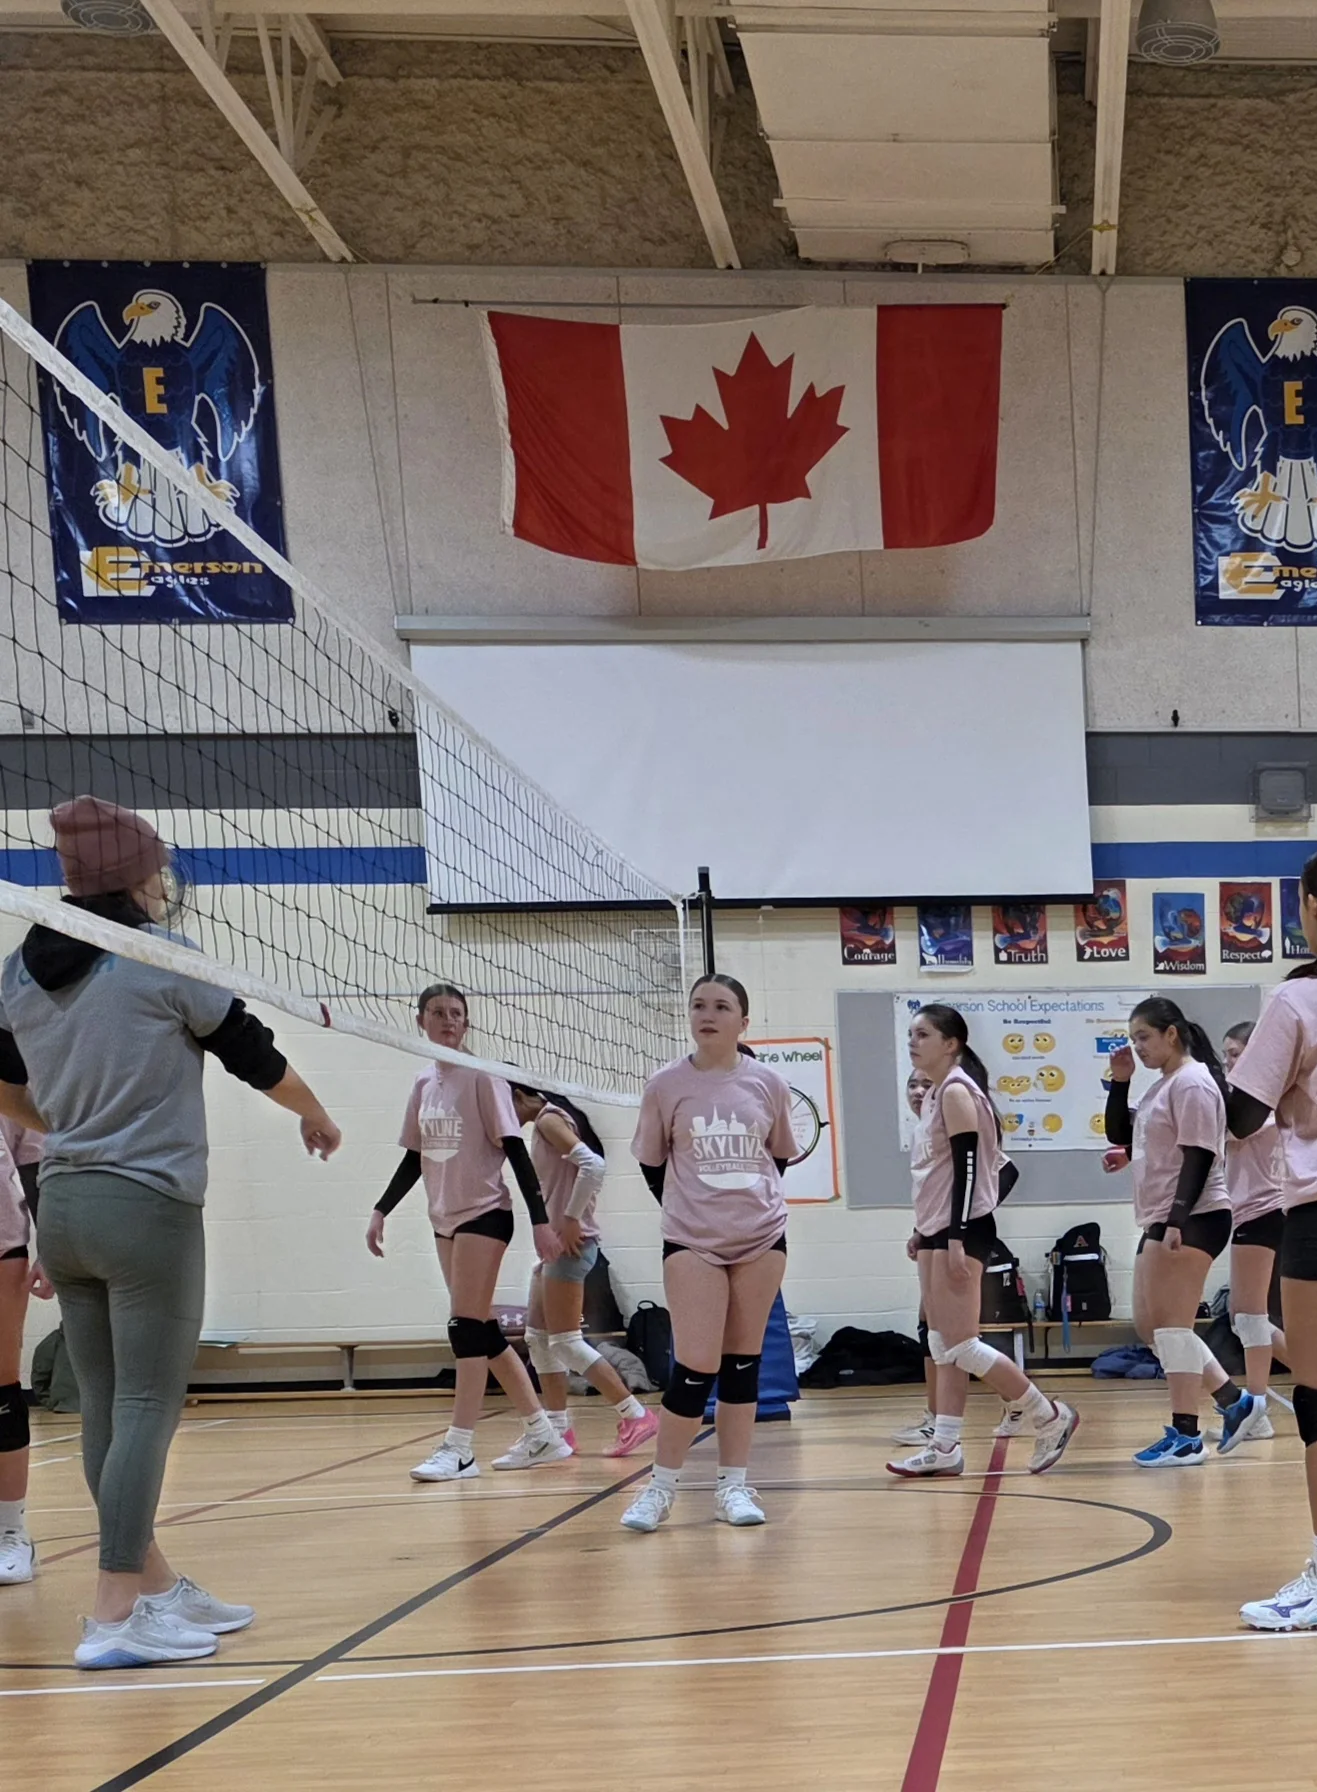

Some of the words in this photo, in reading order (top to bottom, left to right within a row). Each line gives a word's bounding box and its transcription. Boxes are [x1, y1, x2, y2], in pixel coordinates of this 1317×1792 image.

[143, 368, 167, 413] E
[1284, 381, 1304, 424] E
[844, 945, 895, 962] Courage
[1010, 950, 1046, 962] Truth
[1093, 946, 1126, 958] Love
[1222, 950, 1260, 963] Respect
[1164, 960, 1205, 971] Wisdom
[987, 999, 1026, 1012] School
[1030, 997, 1105, 1016] Expectations
[781, 1050, 823, 1062] Wheel
